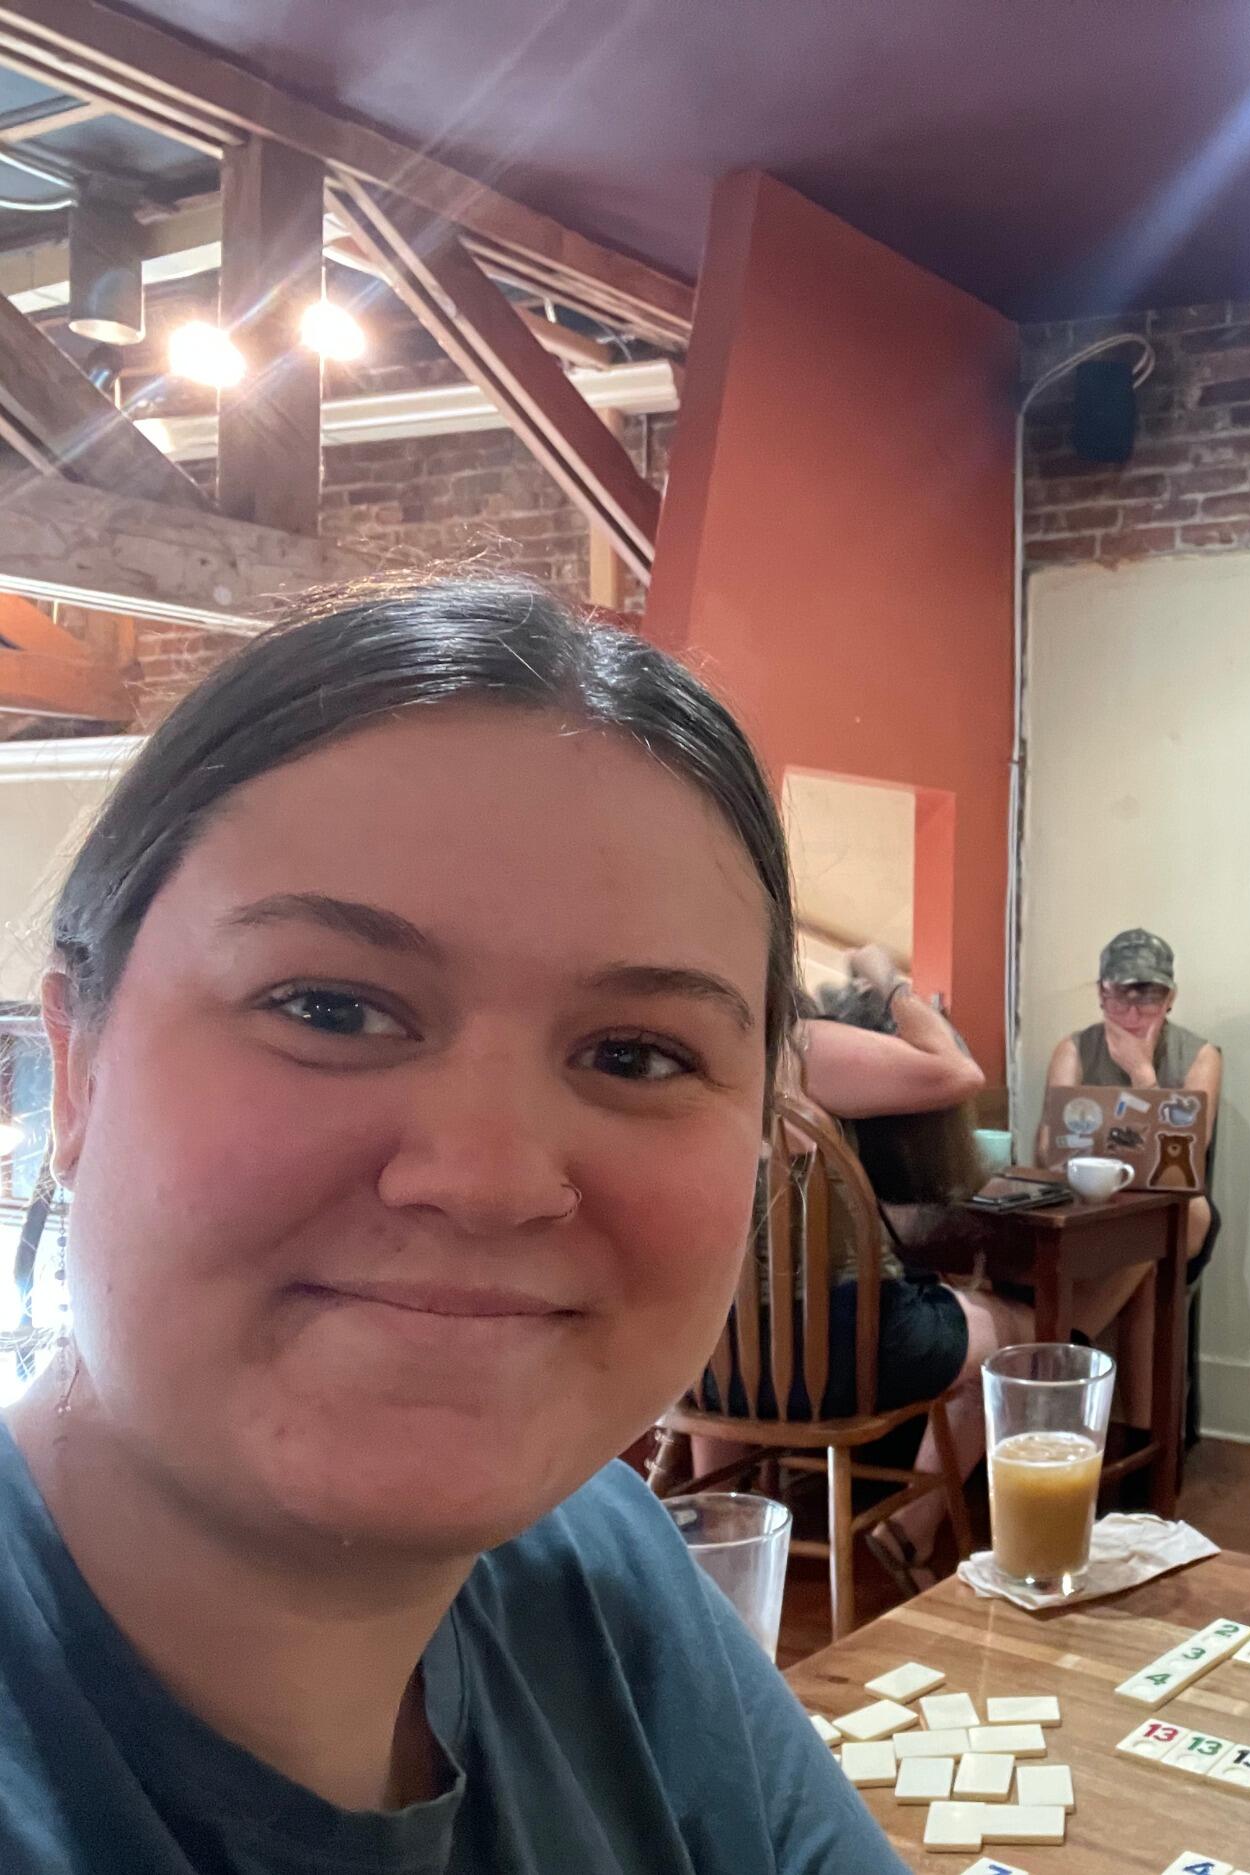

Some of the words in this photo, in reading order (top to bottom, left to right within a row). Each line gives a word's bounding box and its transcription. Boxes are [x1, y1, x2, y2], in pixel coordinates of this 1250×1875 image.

[1214, 1624, 1240, 1638] 2
[1183, 1647, 1206, 1661] 3
[1146, 1672, 1171, 1686] 4
[1144, 1723, 1178, 1743] 13
[1188, 1736, 1223, 1756] 13
